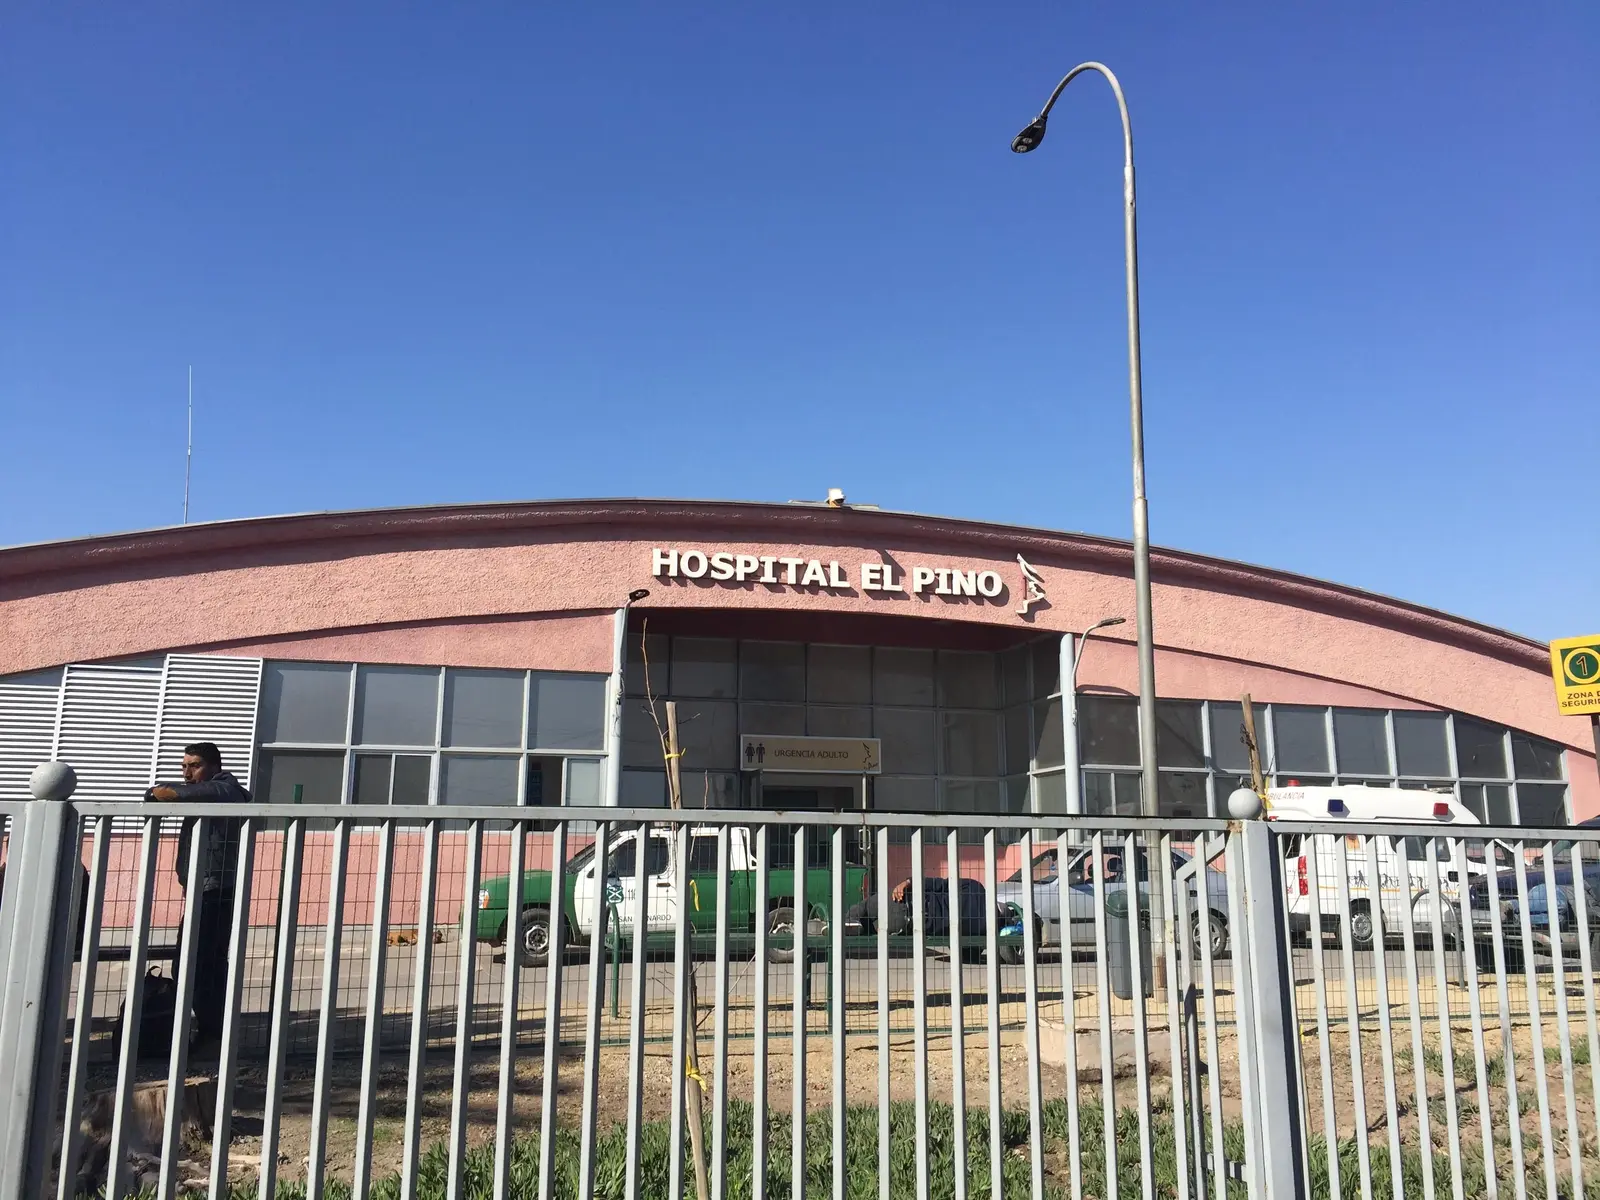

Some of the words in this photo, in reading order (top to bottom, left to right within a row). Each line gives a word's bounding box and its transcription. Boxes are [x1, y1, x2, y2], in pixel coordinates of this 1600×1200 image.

[652, 548, 850, 588] HOSPITAL
[861, 563, 903, 592] EL
[913, 566, 1003, 597] PINO
[1576, 655, 1588, 676] 1
[1567, 691, 1594, 699] ZONA
[774, 749, 815, 758] URGENCIA
[817, 751, 849, 759] ADULTO
